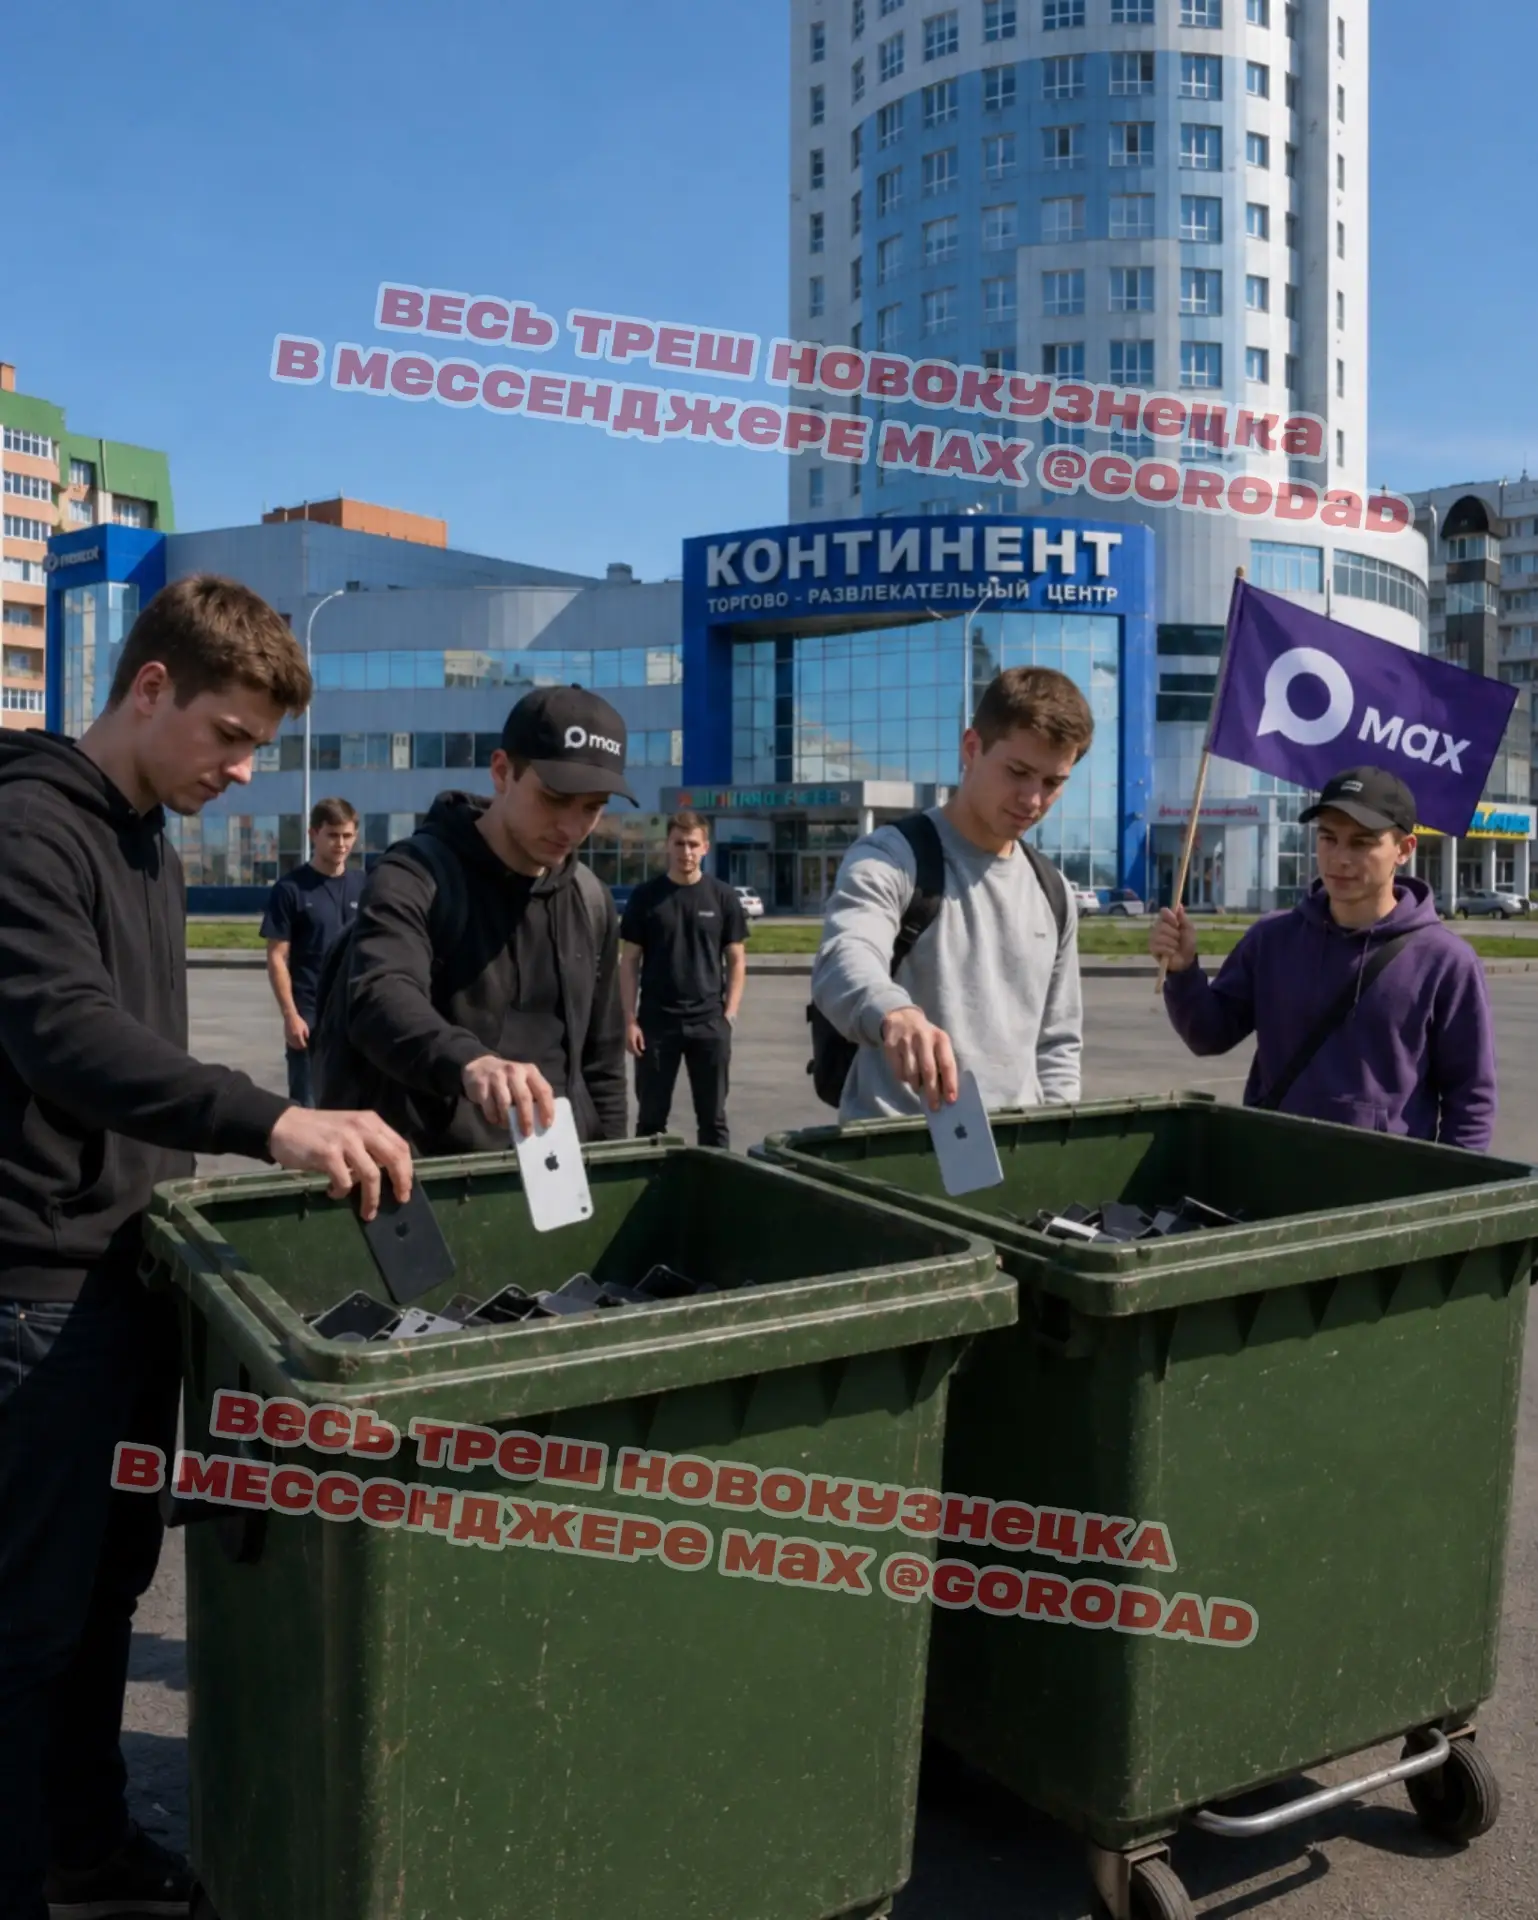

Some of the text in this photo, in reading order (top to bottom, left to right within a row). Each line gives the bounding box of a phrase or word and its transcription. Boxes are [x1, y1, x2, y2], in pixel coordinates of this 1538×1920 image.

[706, 526, 1122, 588] КОНТИНЕНТ
[705, 591, 790, 615] ТОРГОВО
[808, 577, 1030, 605] РАЗВЛЕКАТЕЛЬНЫЙ
[1046, 583, 1118, 603] ЦЕНТР
[588, 733, 623, 757] max
